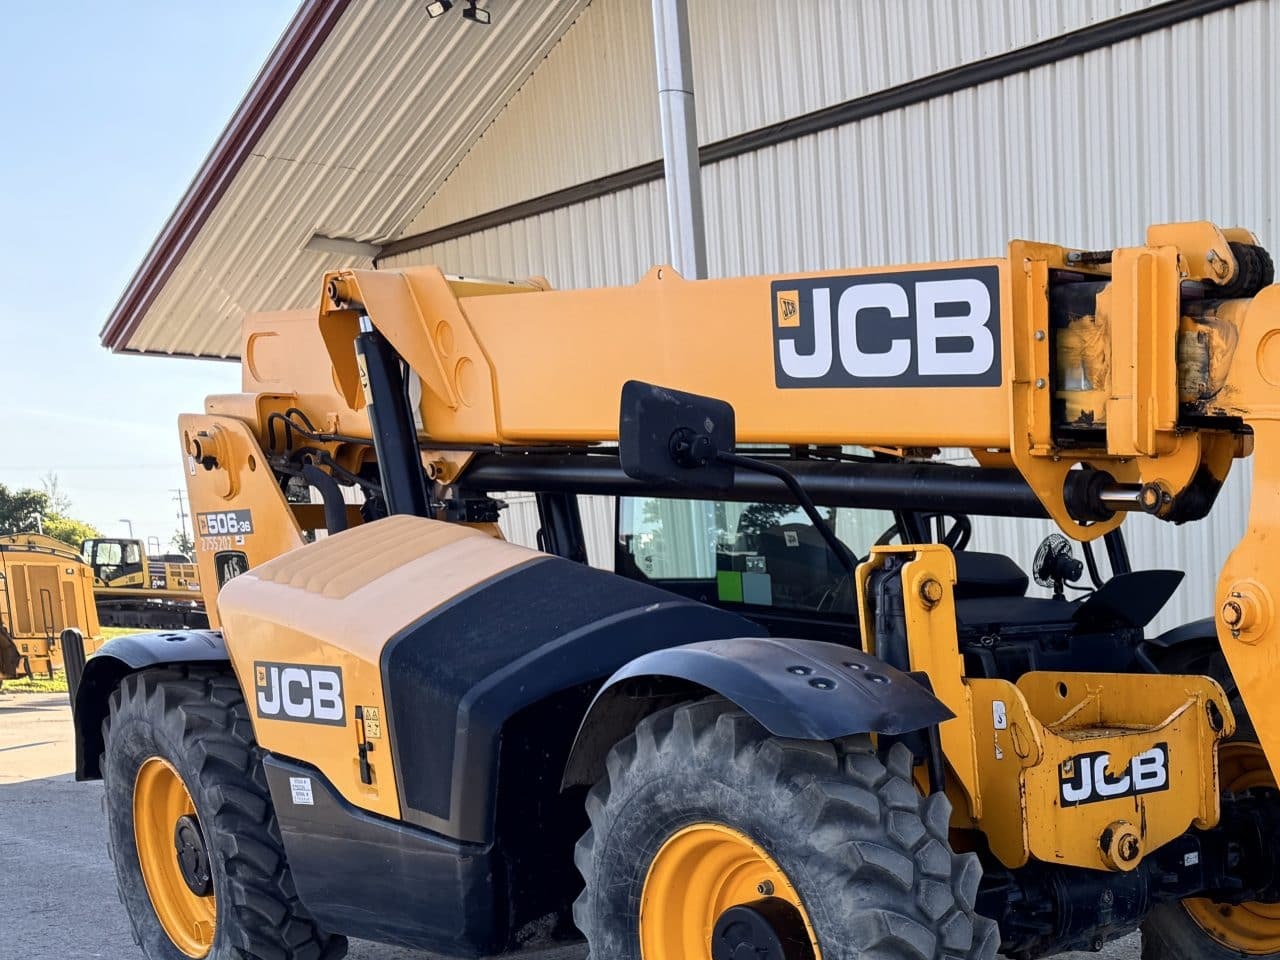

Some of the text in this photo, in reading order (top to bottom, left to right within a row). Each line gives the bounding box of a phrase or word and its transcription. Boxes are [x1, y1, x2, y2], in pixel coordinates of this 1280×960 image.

[779, 279, 994, 378] JCB
[783, 299, 797, 318] JCB
[258, 667, 343, 720] JCB
[1062, 748, 1166, 802] JCB
